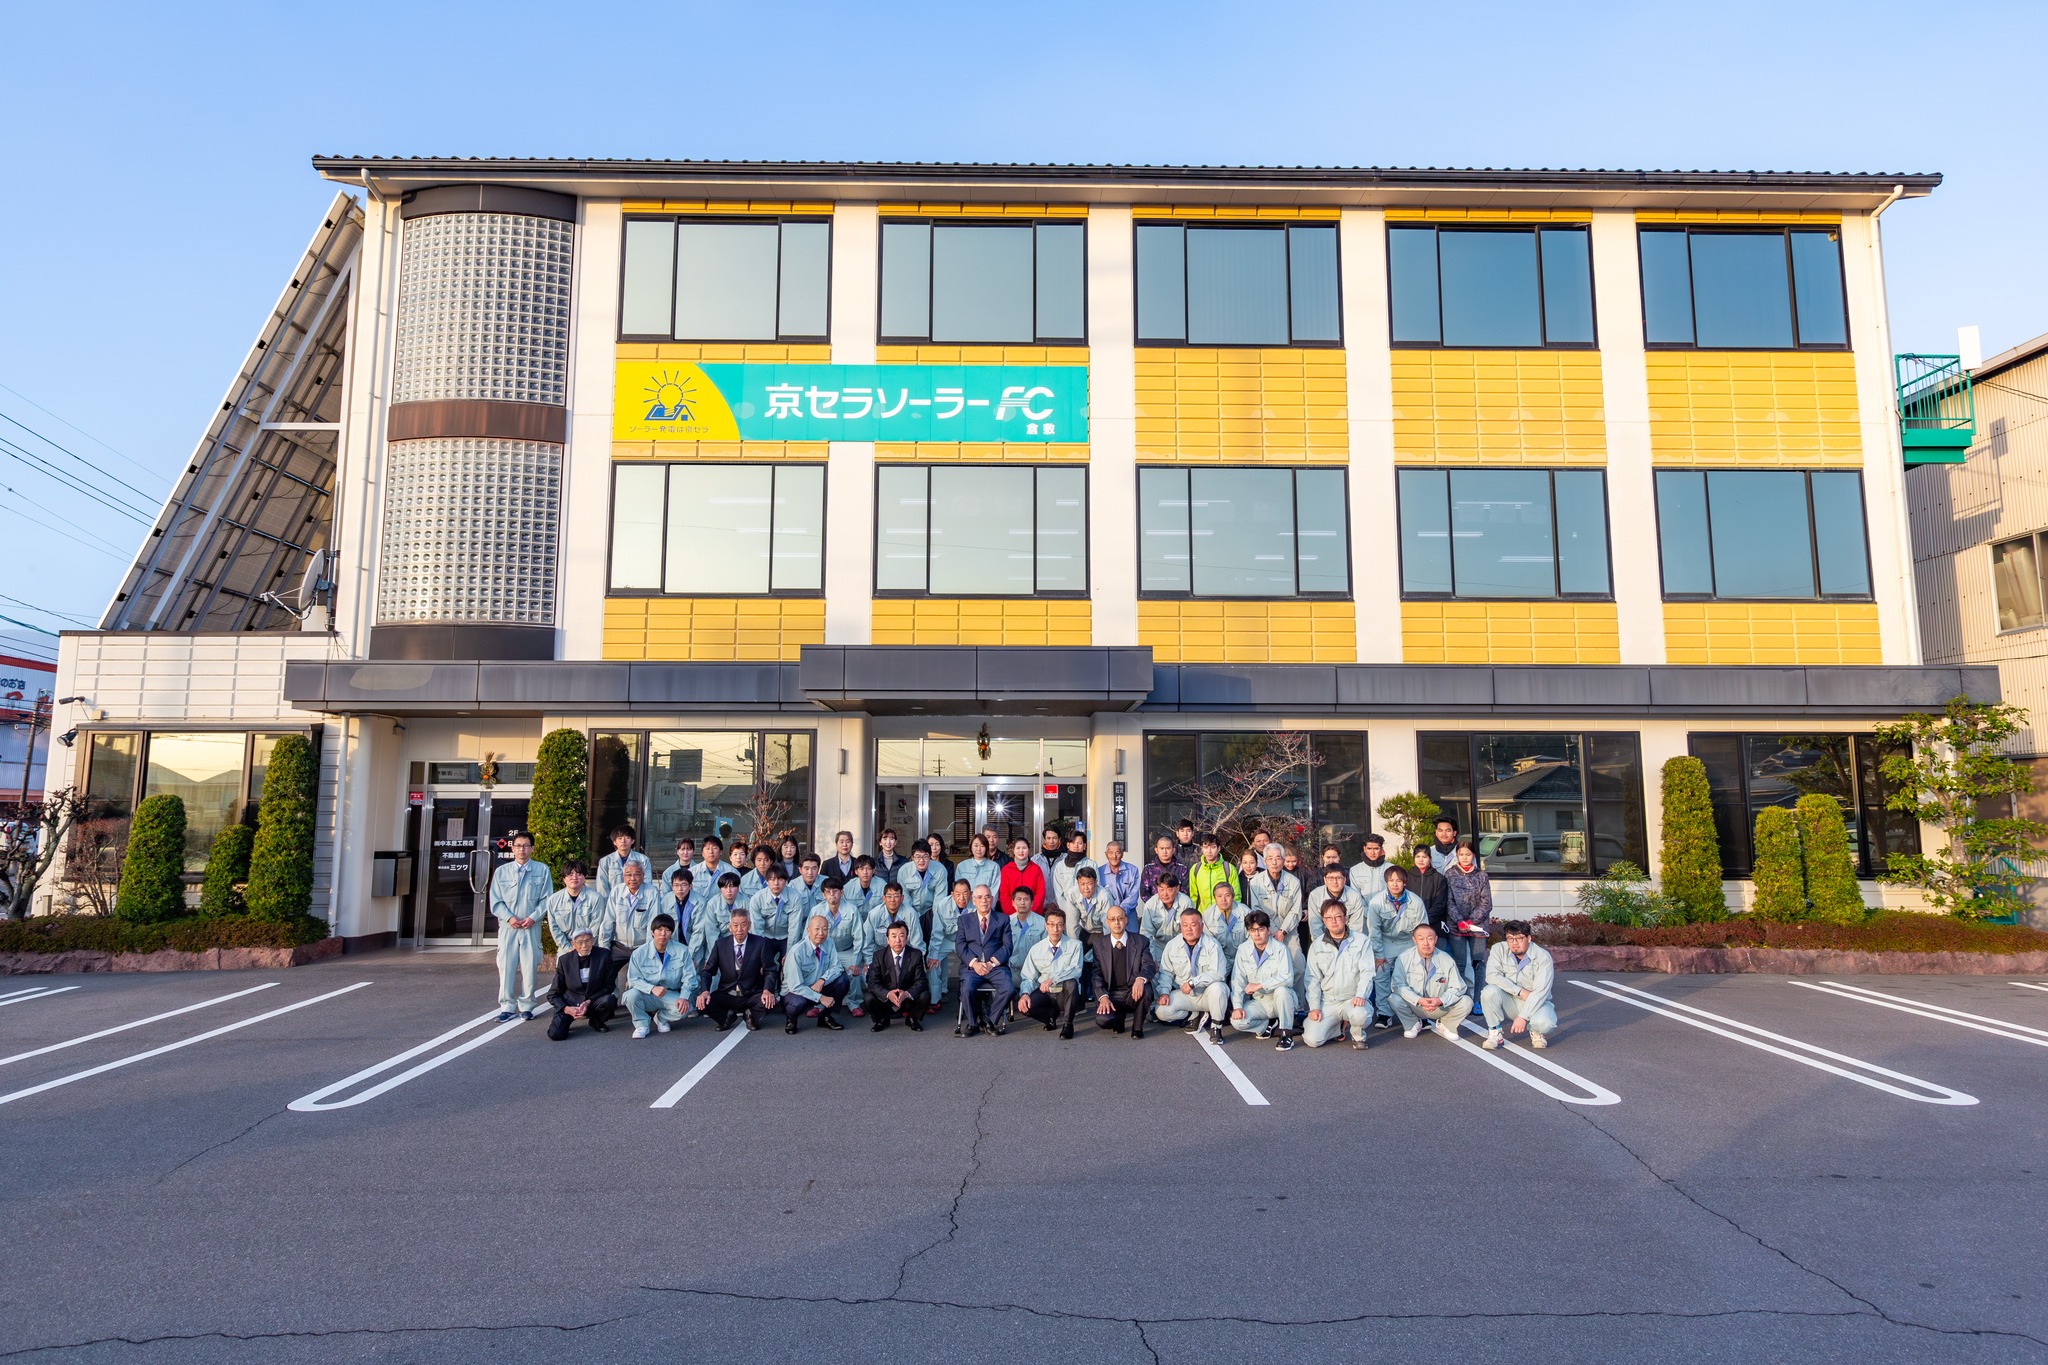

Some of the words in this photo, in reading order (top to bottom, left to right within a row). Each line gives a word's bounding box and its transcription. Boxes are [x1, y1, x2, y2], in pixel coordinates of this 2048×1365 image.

[764, 382, 990, 420] 京セラソーラー
[995, 386, 1055, 420] FC
[629, 425, 709, 434] ソーラー発電は京セラ
[1026, 423, 1055, 435] 倉敷
[0, 677, 26, 690] のお店
